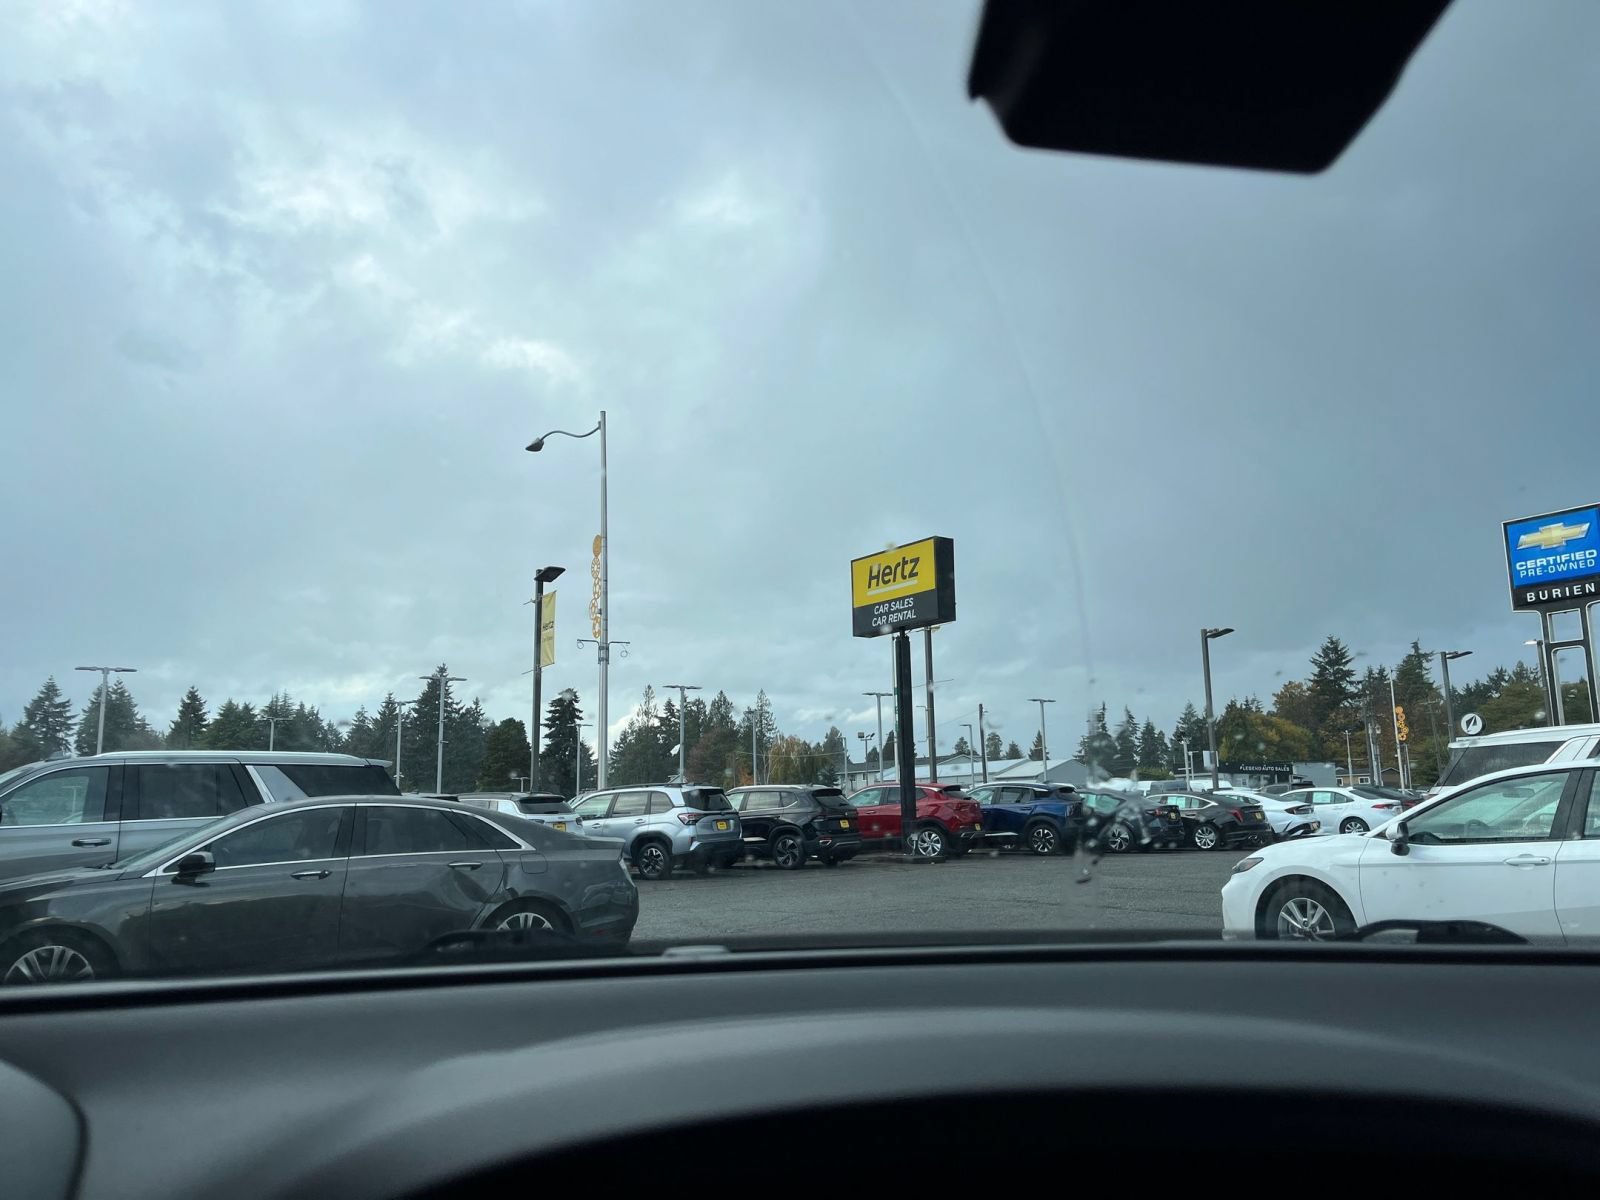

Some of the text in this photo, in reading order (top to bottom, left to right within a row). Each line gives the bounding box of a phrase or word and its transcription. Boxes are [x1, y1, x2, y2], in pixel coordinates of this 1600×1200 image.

[1516, 549, 1597, 570] CERTIFIED
[1520, 559, 1595, 578] PRE-OWNED
[868, 556, 920, 589] Hertz
[1526, 582, 1595, 602] BURIEN
[874, 597, 914, 615] CAR SALES
[871, 609, 917, 627] CAR RENTAL
